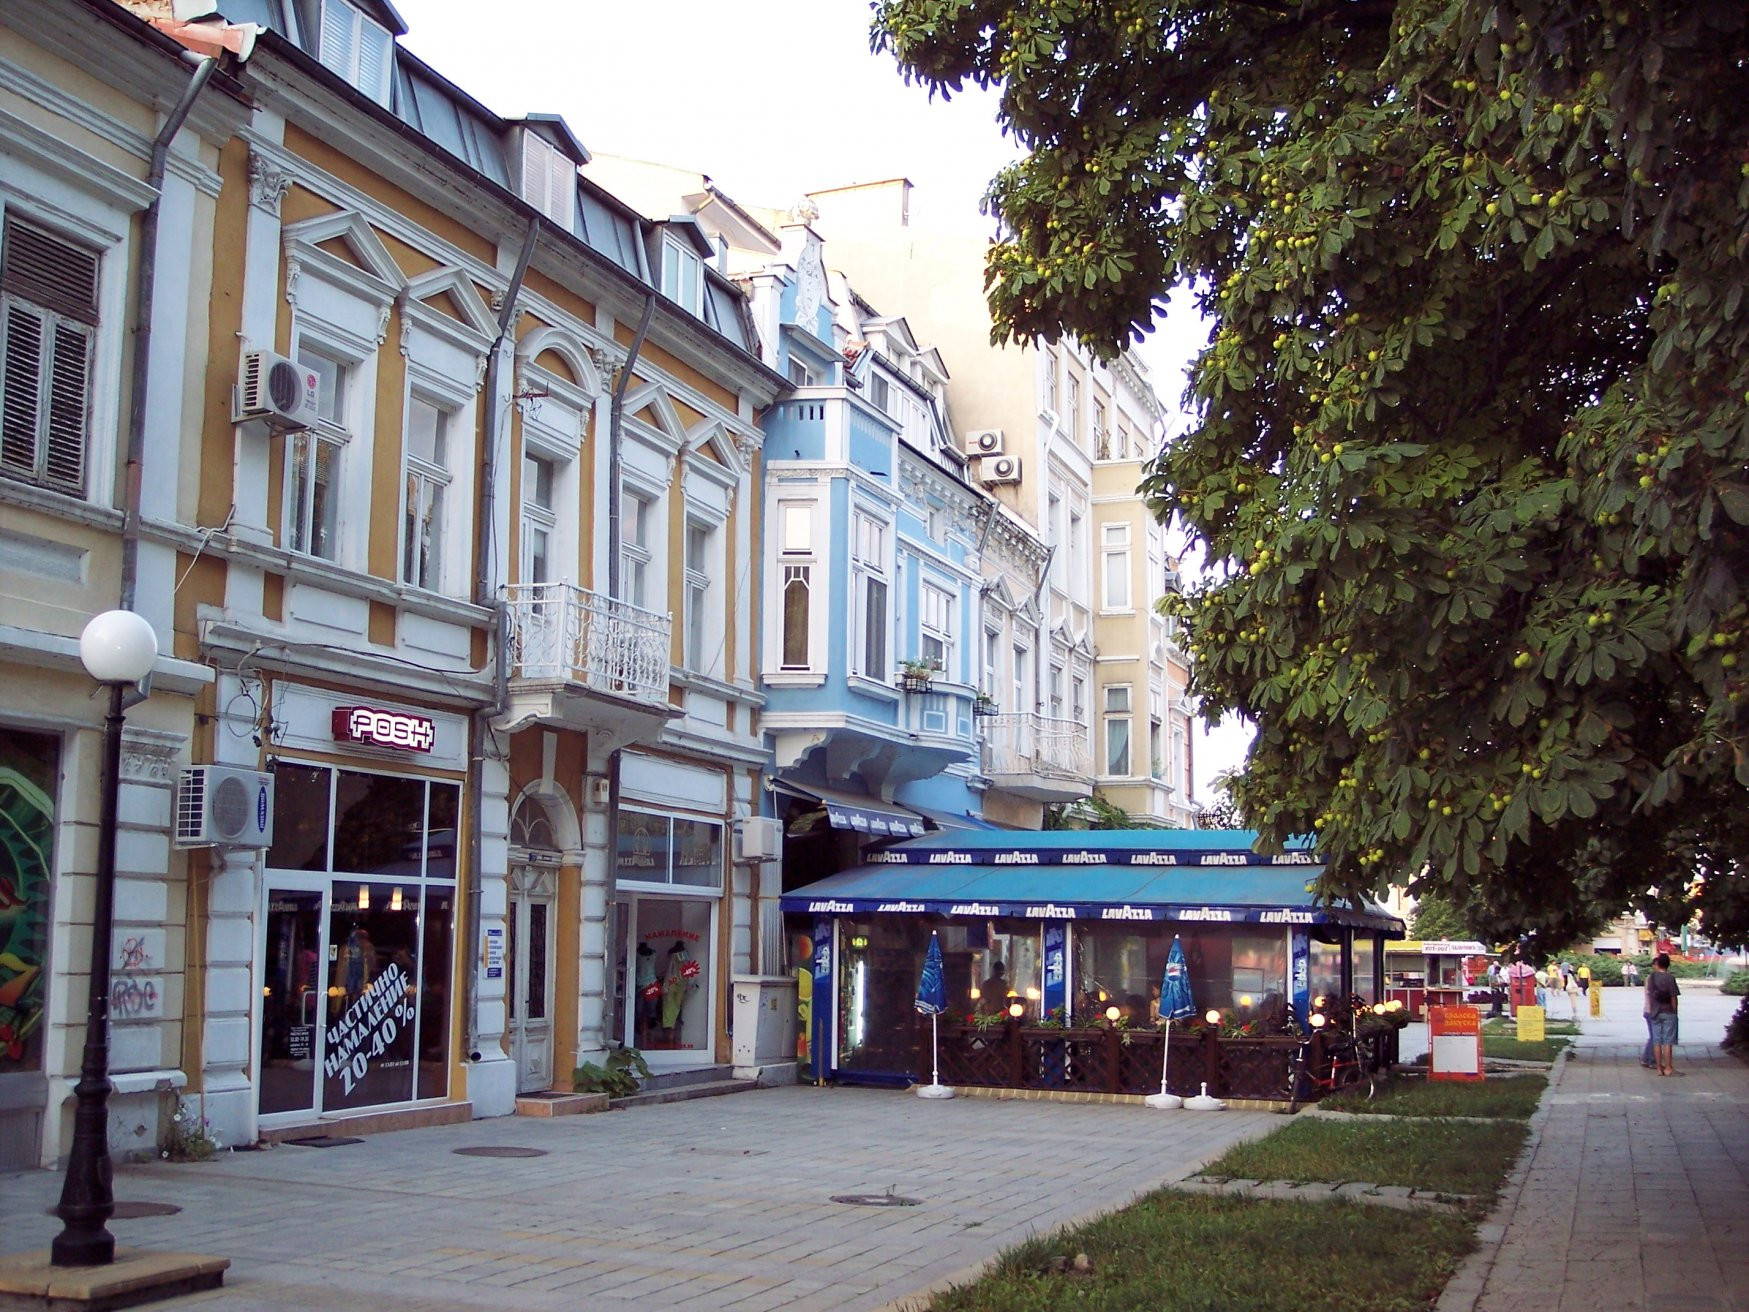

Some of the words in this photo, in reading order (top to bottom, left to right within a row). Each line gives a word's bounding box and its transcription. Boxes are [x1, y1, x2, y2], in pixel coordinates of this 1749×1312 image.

[350, 710, 433, 749] POSH
[867, 851, 907, 863] LAVAZZA
[929, 852, 972, 863] LAVAZZA
[995, 851, 1039, 864] LAVAZZA
[1062, 851, 1107, 864] LAVAZZA
[1131, 852, 1176, 864] LAVAZZA
[1200, 852, 1247, 865] LAVAZZA
[808, 901, 854, 912] LAVAZZA
[950, 903, 999, 916] LAVAZZA
[1025, 904, 1075, 918] LAVAZZA
[1101, 905, 1152, 920] LAVAZZA
[1178, 907, 1232, 921] LAVAZZA
[1259, 908, 1314, 923] LAVAZZA
[327, 962, 399, 1044] ЧАСТИЧНО
[324, 971, 409, 1078] НАМАЛЕНИЕ
